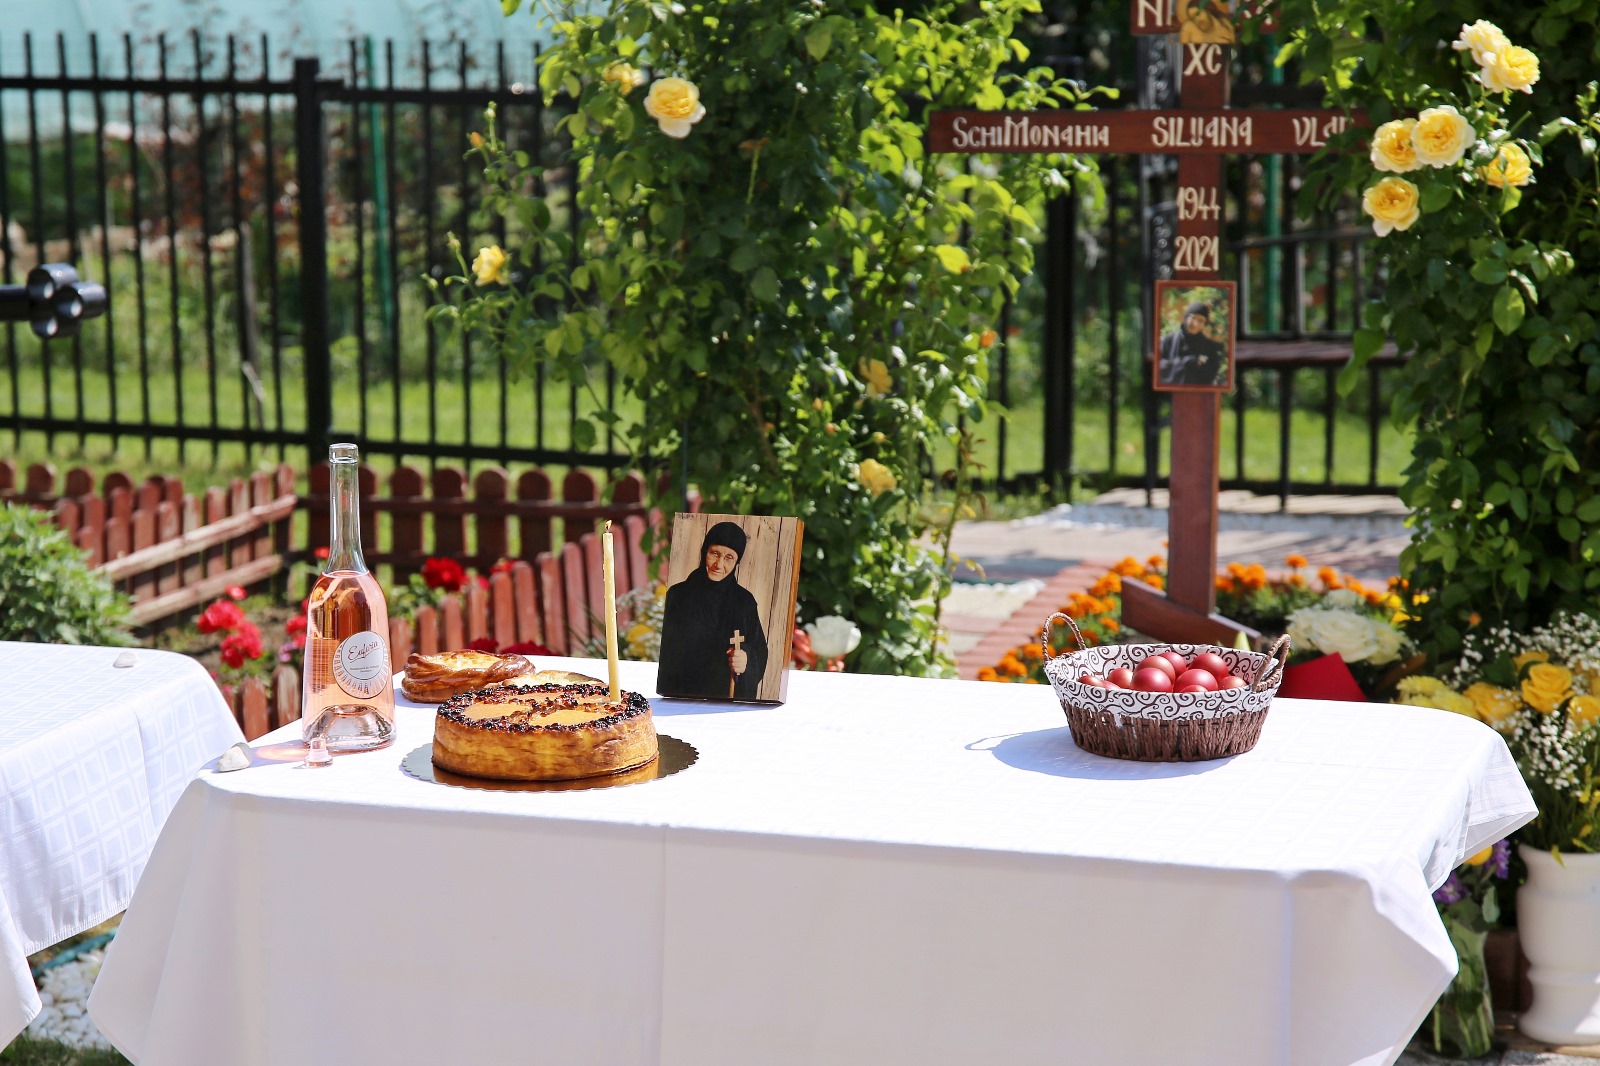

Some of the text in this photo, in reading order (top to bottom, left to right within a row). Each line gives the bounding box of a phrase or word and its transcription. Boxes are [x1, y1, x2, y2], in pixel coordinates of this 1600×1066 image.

[1183, 43, 1222, 76] XC
[1176, 187, 1222, 220] 1944
[1174, 235, 1219, 271] 2021
